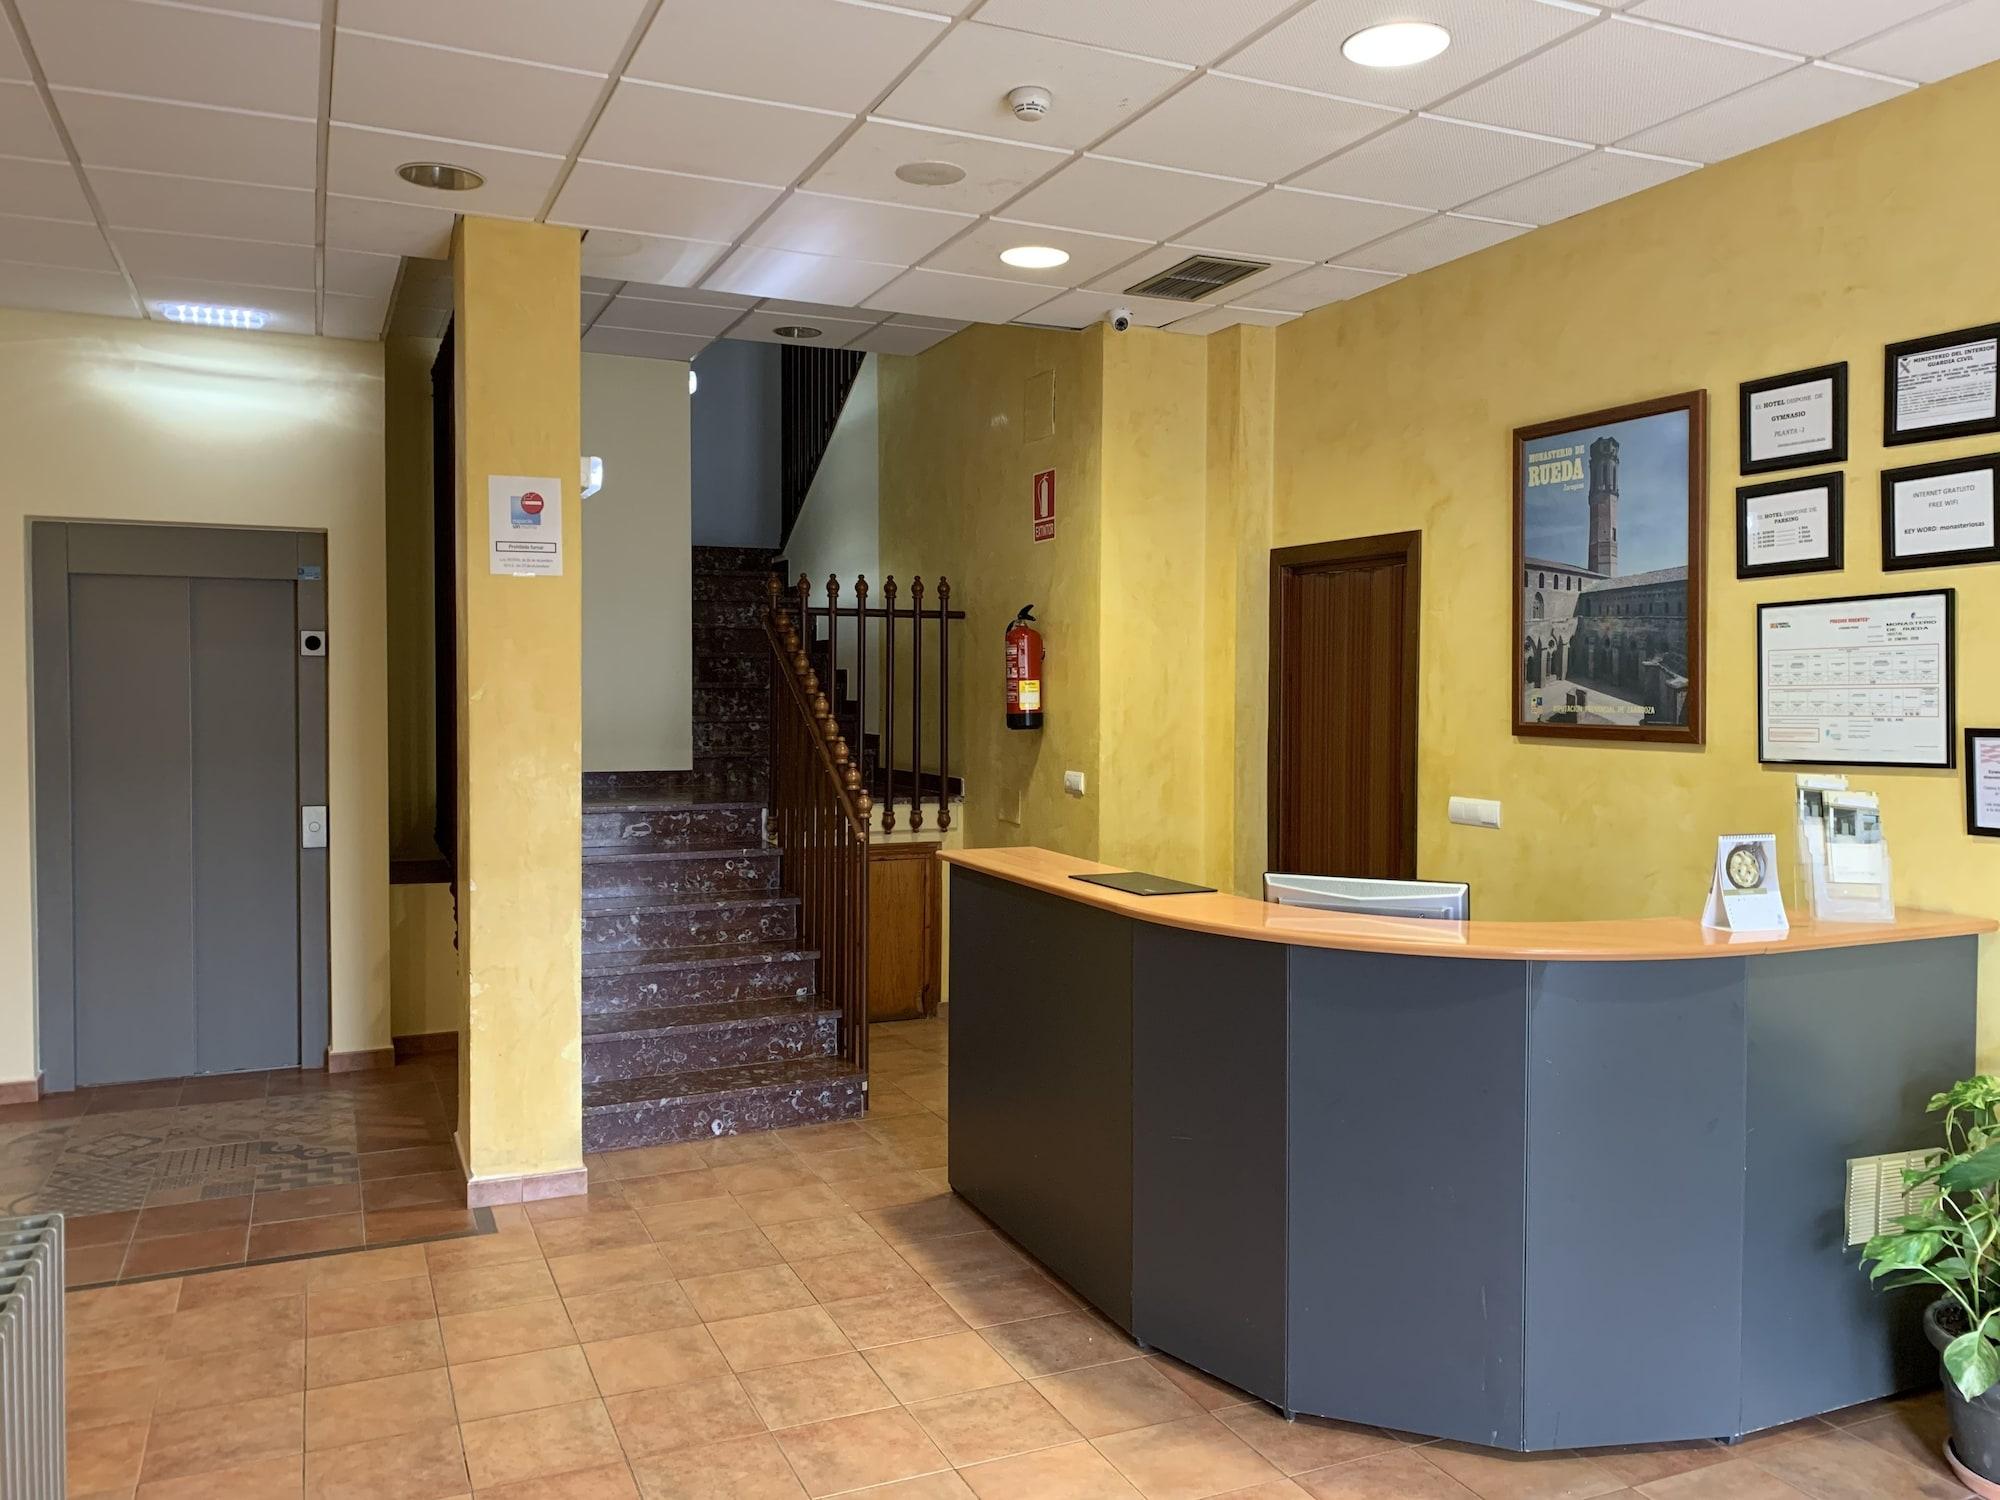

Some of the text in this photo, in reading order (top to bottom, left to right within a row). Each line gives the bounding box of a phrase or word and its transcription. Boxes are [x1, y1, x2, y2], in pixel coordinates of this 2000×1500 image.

[1913, 352, 1950, 363] MINISTERIO
[1964, 345, 1995, 355] INTERIOR
[1927, 355, 1974, 367] GUARDIA CIVIL
[1763, 399, 1786, 409] HOTEL
[1771, 410, 1806, 422] GYMNASIO
[1528, 445, 1585, 463] MONASTERIO DE
[1528, 458, 1585, 487] RUEDA
[1913, 485, 1976, 498] INTERNET GRATUITO
[1928, 499, 1959, 508] FREE WIFI
[1774, 516, 1799, 524] PARKING
[1904, 527, 1915, 535] KEY
